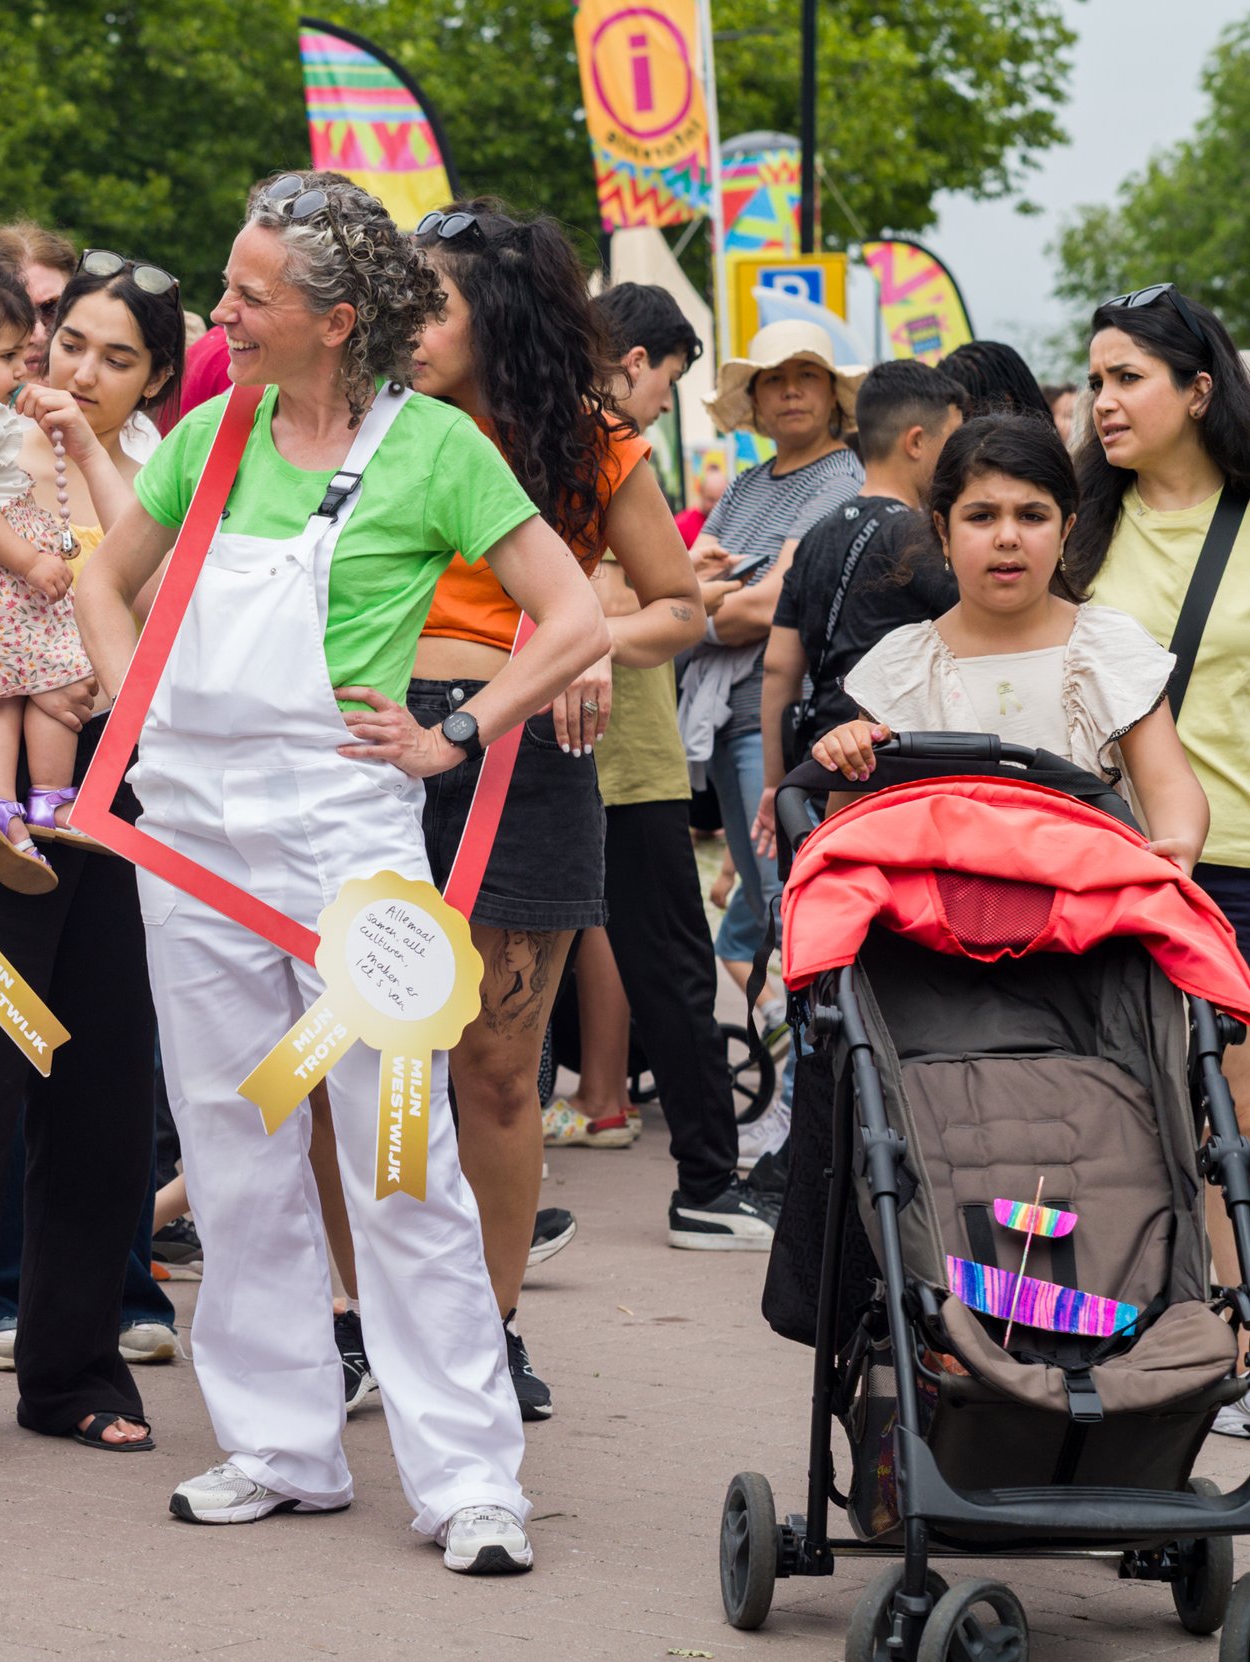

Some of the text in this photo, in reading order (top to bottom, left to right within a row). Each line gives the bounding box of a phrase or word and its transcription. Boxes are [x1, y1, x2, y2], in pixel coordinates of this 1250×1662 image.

[825, 518, 880, 641] UNDER ARMOUR
[385, 905, 435, 944] Allemaal
[403, 938, 425, 957] alle
[367, 952, 419, 997] maken er
[389, 989, 404, 1012] van
[292, 1008, 335, 1053] MIJN
[293, 1023, 348, 1080] TROTS
[409, 1058, 423, 1118] MIJN
[387, 1056, 405, 1184] WESTWIJK
